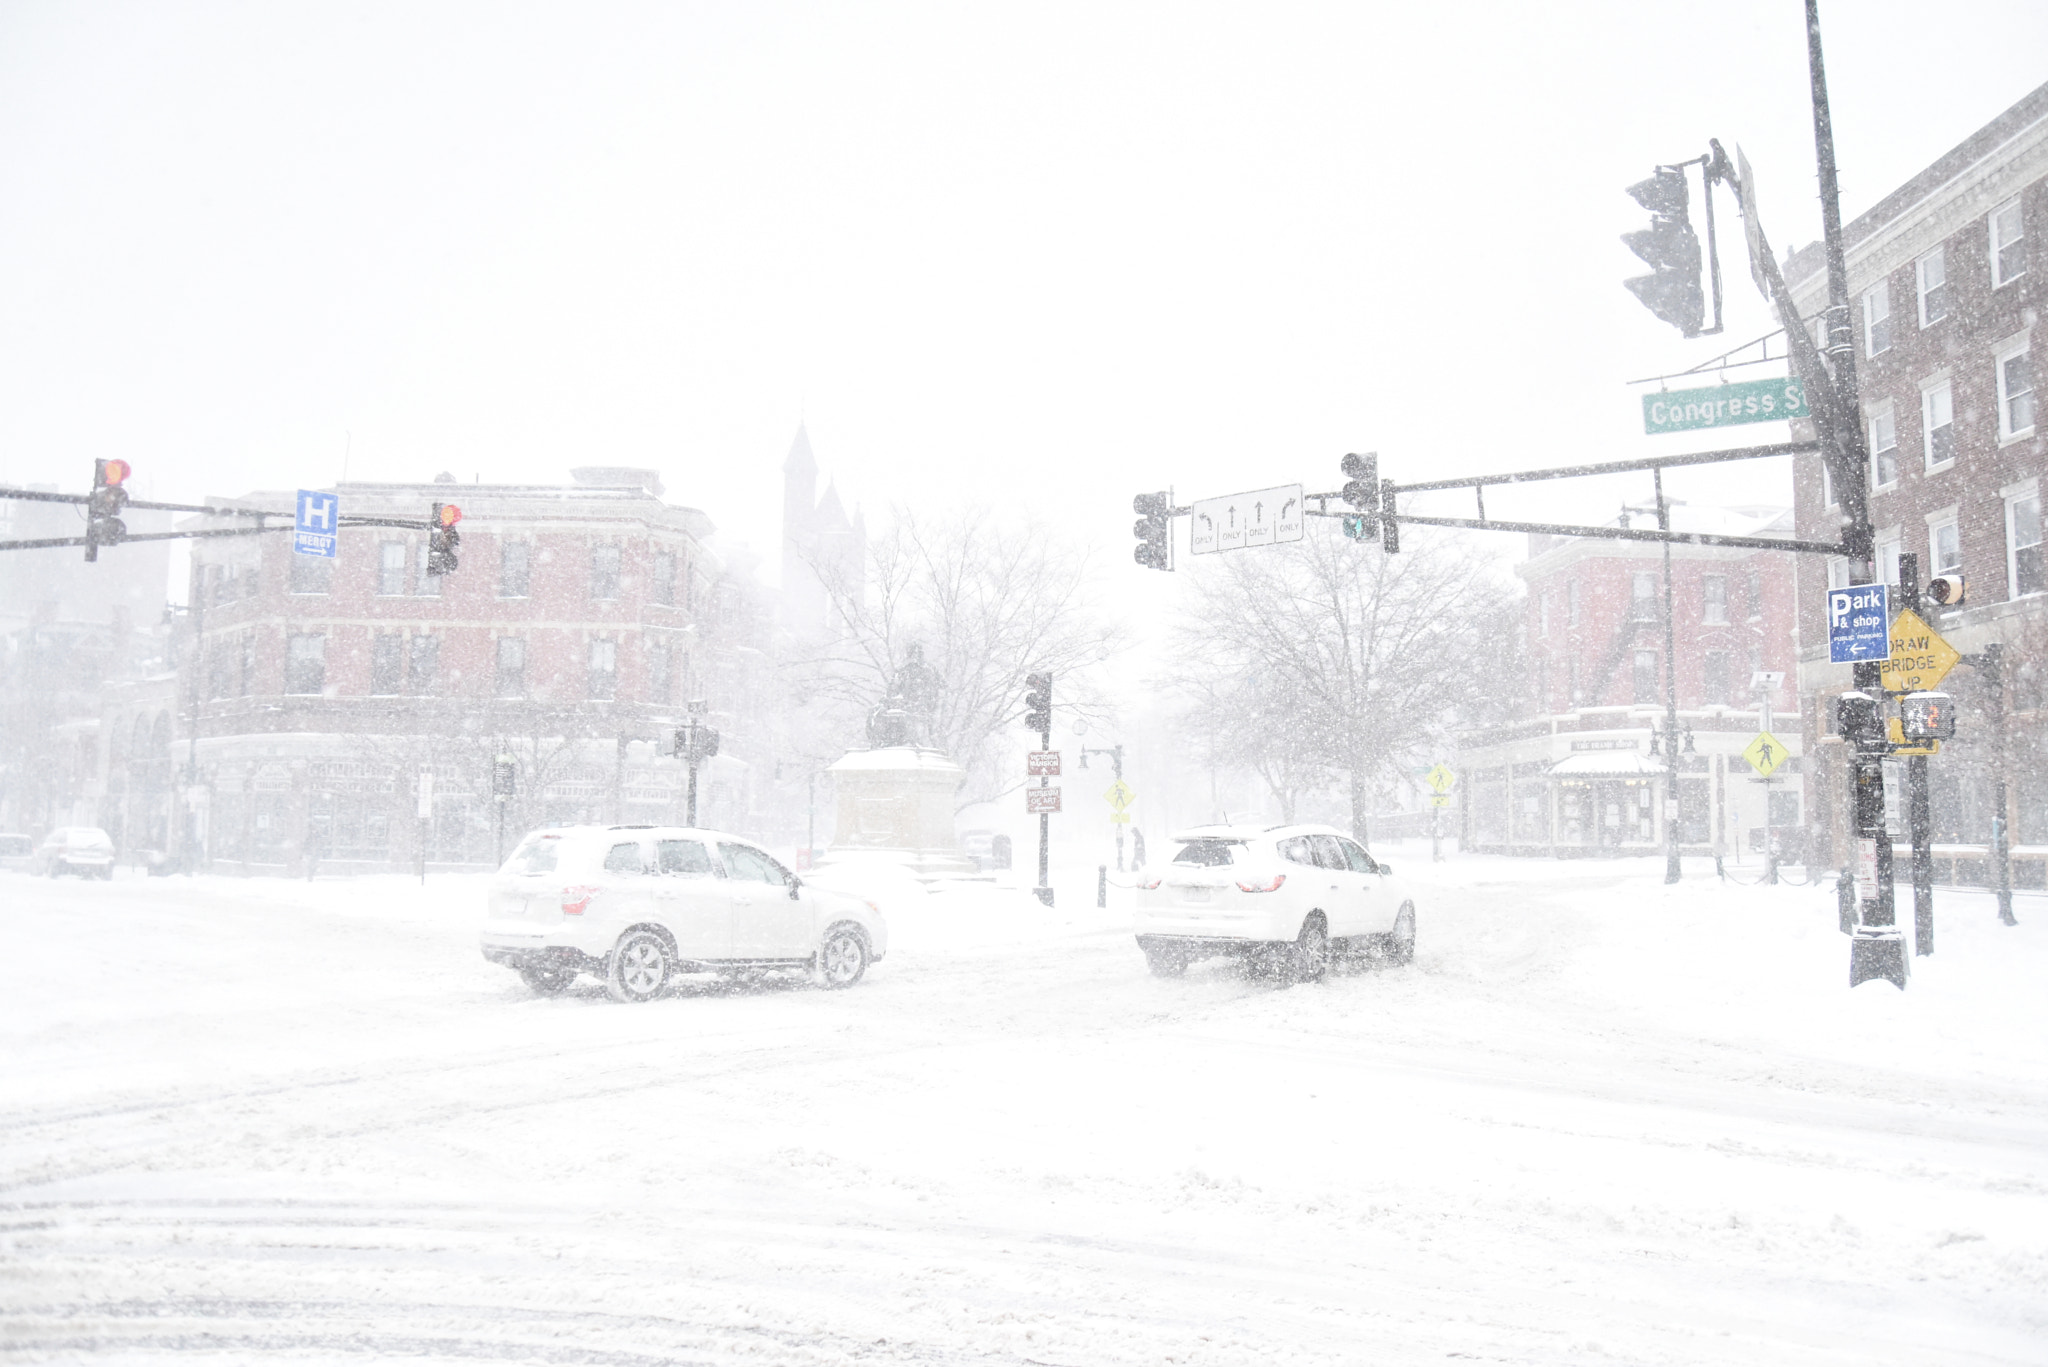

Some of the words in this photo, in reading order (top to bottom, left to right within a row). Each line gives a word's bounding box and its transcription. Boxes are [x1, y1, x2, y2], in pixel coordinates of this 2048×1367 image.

[1651, 393, 1775, 425] Congress
[304, 496, 331, 529] H
[299, 535, 331, 548] MERCY
[1195, 535, 1214, 545] ONLY
[1222, 530, 1241, 541] ONLY
[1249, 527, 1269, 537] ONLY
[1280, 522, 1299, 533] ONLY
[1831, 590, 1881, 628] Park
[1840, 616, 1849, 629] &
[1853, 614, 1880, 628] shop
[1881, 655, 1936, 673] BRIDGE
[1900, 676, 1921, 691] UP
